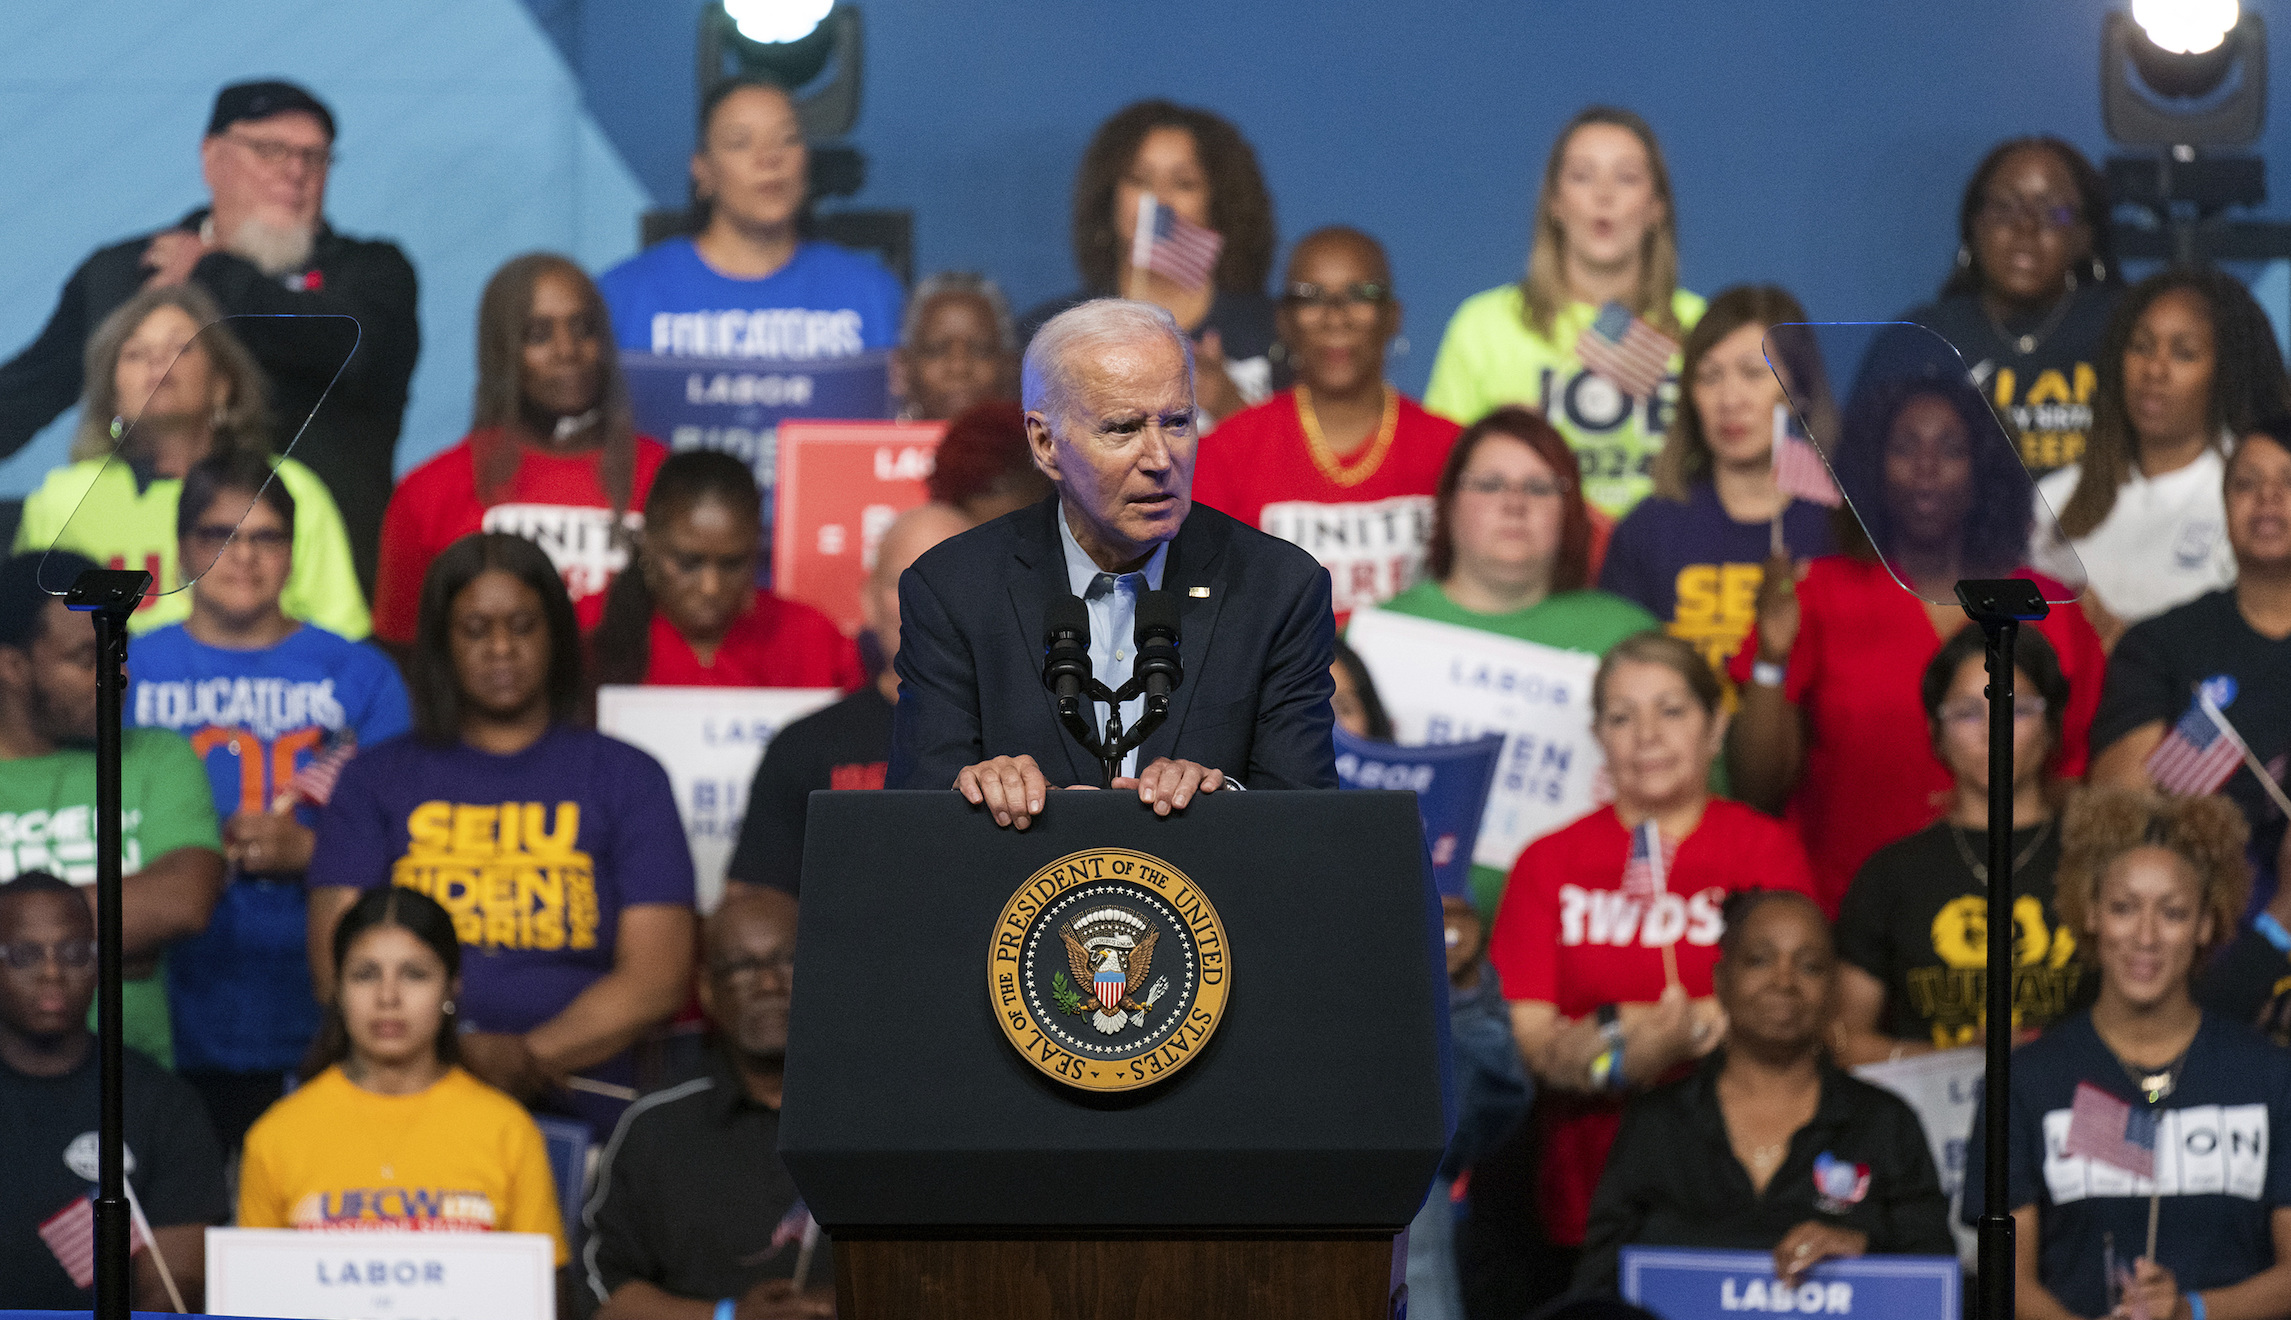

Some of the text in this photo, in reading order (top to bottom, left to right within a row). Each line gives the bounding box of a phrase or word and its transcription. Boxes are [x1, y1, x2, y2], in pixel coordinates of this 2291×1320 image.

[407, 801, 581, 853] SEIU
[1560, 884, 1728, 948] RWDS
[997, 857, 1223, 1081] SEAL OF THE PRESIDENT OF THE UNITED STATES
[315, 1258, 446, 1286] LABOR
[1721, 1277, 1853, 1315] LABOR
